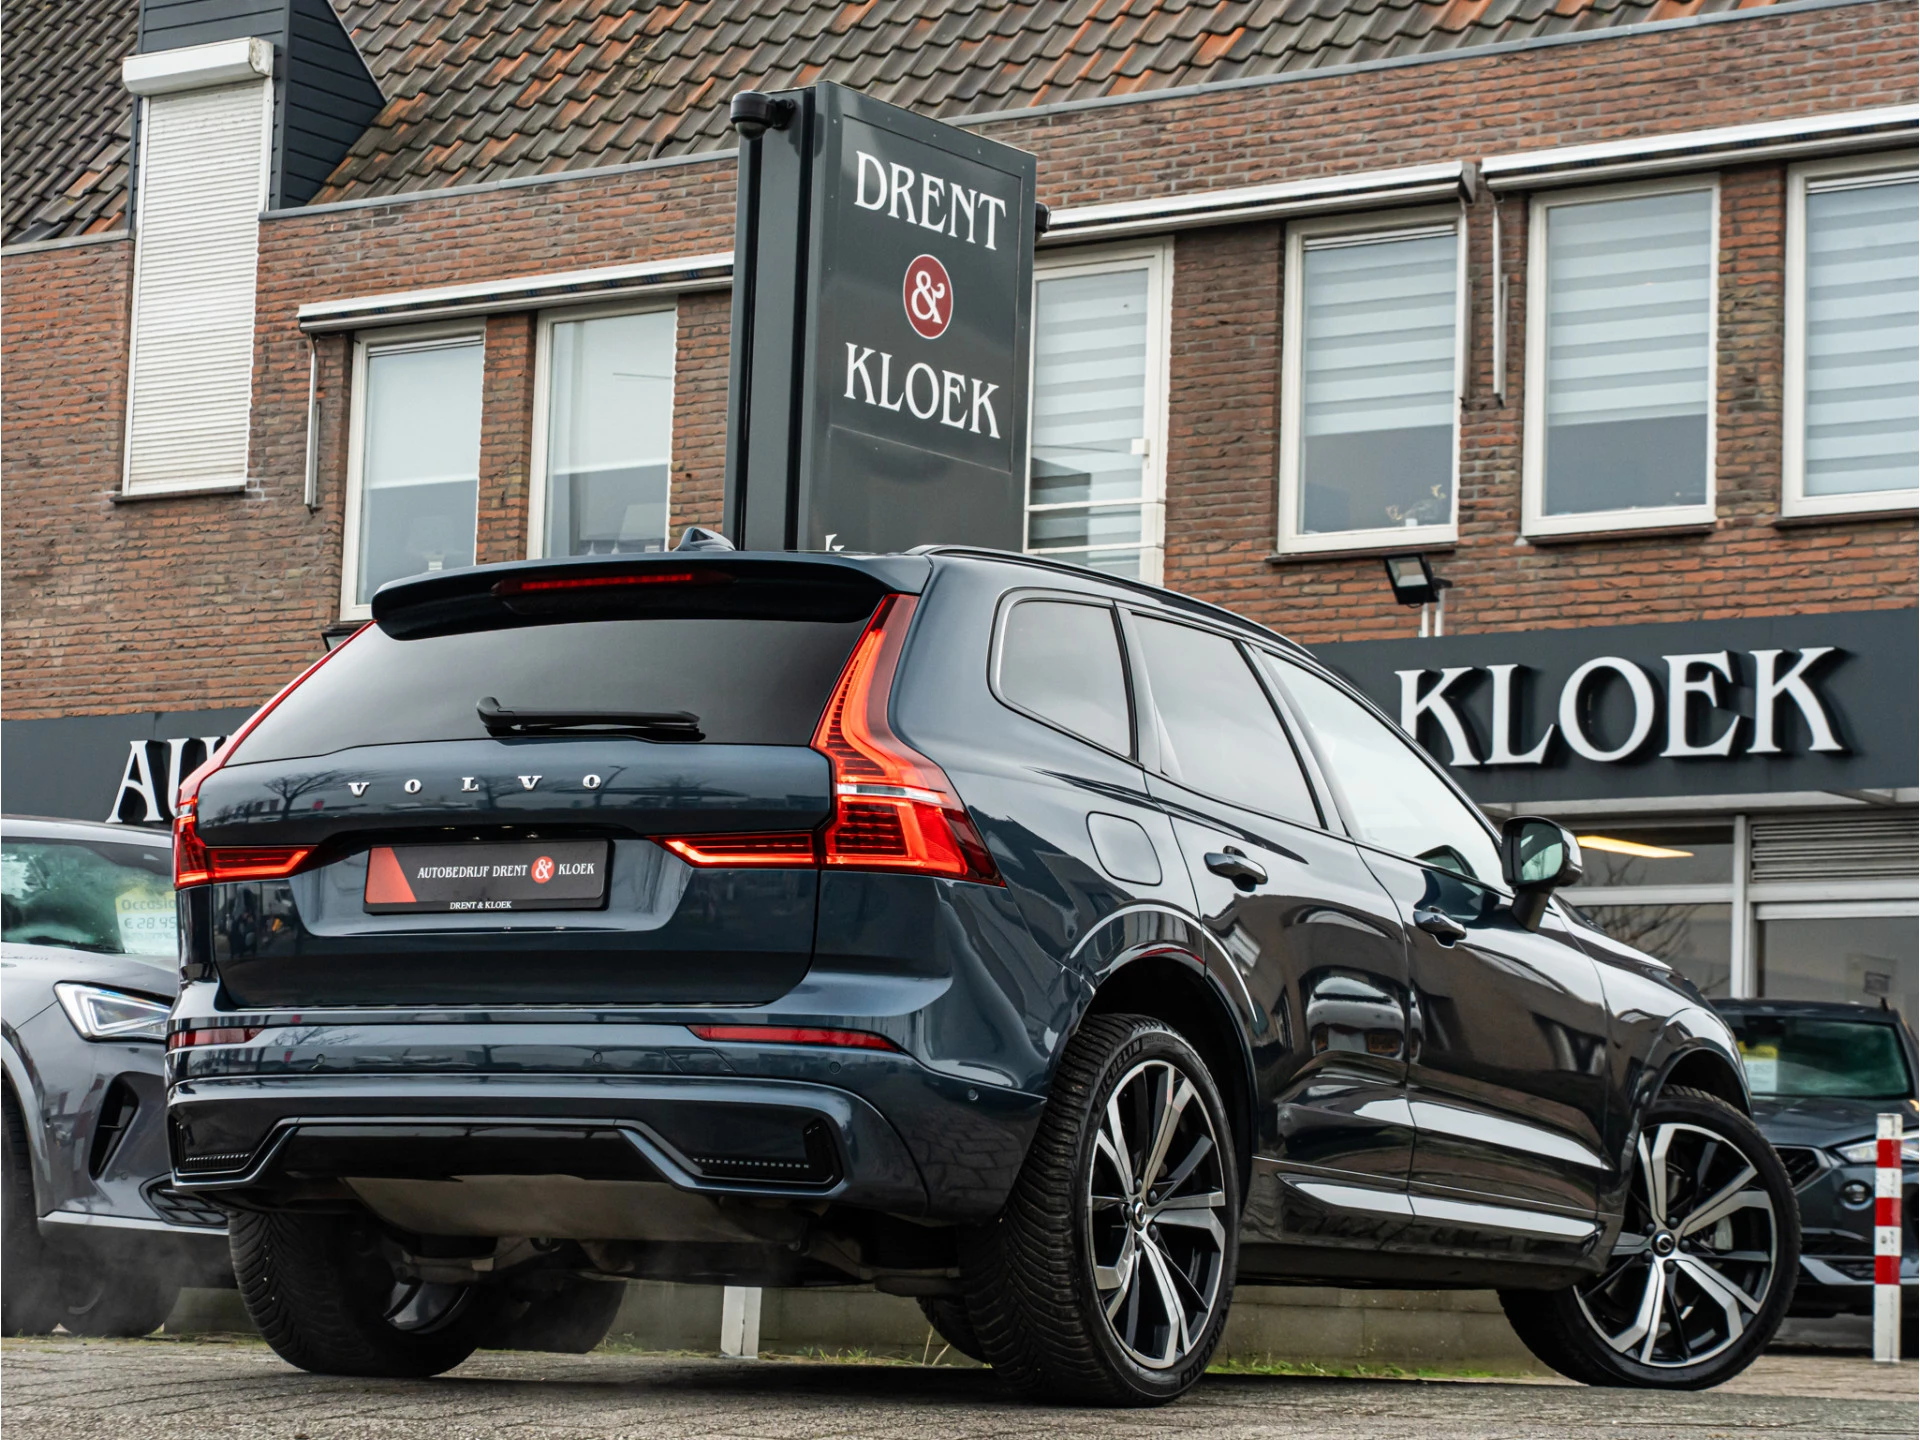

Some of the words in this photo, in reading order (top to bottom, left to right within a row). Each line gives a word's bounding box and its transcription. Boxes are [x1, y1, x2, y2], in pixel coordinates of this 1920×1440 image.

[854, 151, 1006, 251] DRENT
[911, 270, 946, 325] &
[844, 343, 1001, 439] KLOEK
[1394, 646, 1844, 767] KLOEK
[105, 735, 231, 823] AU
[348, 774, 602, 797] VOLVO
[417, 866, 490, 879] AUTOBEDRIJF
[492, 864, 528, 877] DRENT
[536, 859, 552, 879] &
[558, 863, 595, 875] KLOEK
[121, 898, 176, 911] Occasio
[449, 902, 477, 910] DRENT
[477, 901, 484, 909] &
[485, 901, 512, 909] KLOEK
[1096, 1038, 1142, 1109] MICHELIN
